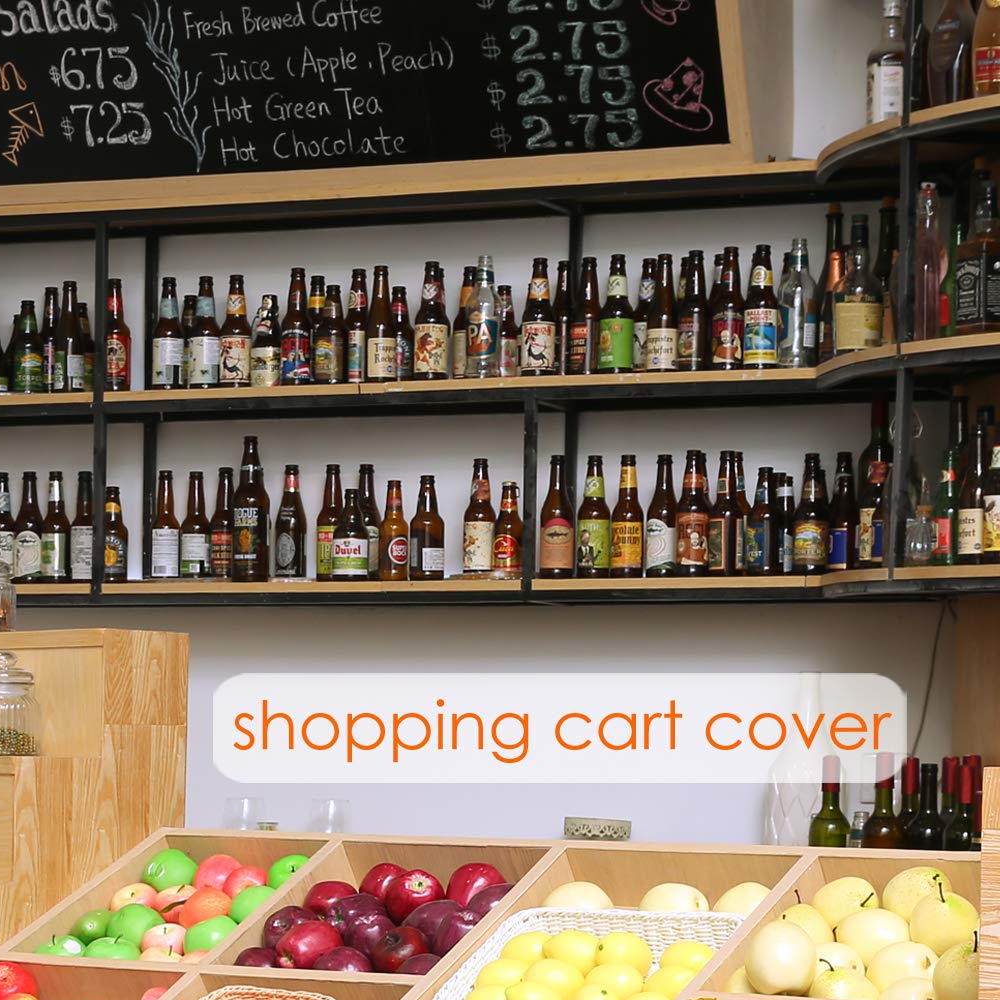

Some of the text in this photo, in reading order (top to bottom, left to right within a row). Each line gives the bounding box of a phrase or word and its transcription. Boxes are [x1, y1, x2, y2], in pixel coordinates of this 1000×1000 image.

[183, 0, 383, 39] Fresh Brewed Coffee
[211, 53, 275, 85] Juice
[212, 88, 383, 126] Hot Green Tea
[220, 126, 408, 165] Hot Chocolate
[335, 544, 361, 555] Duvel
